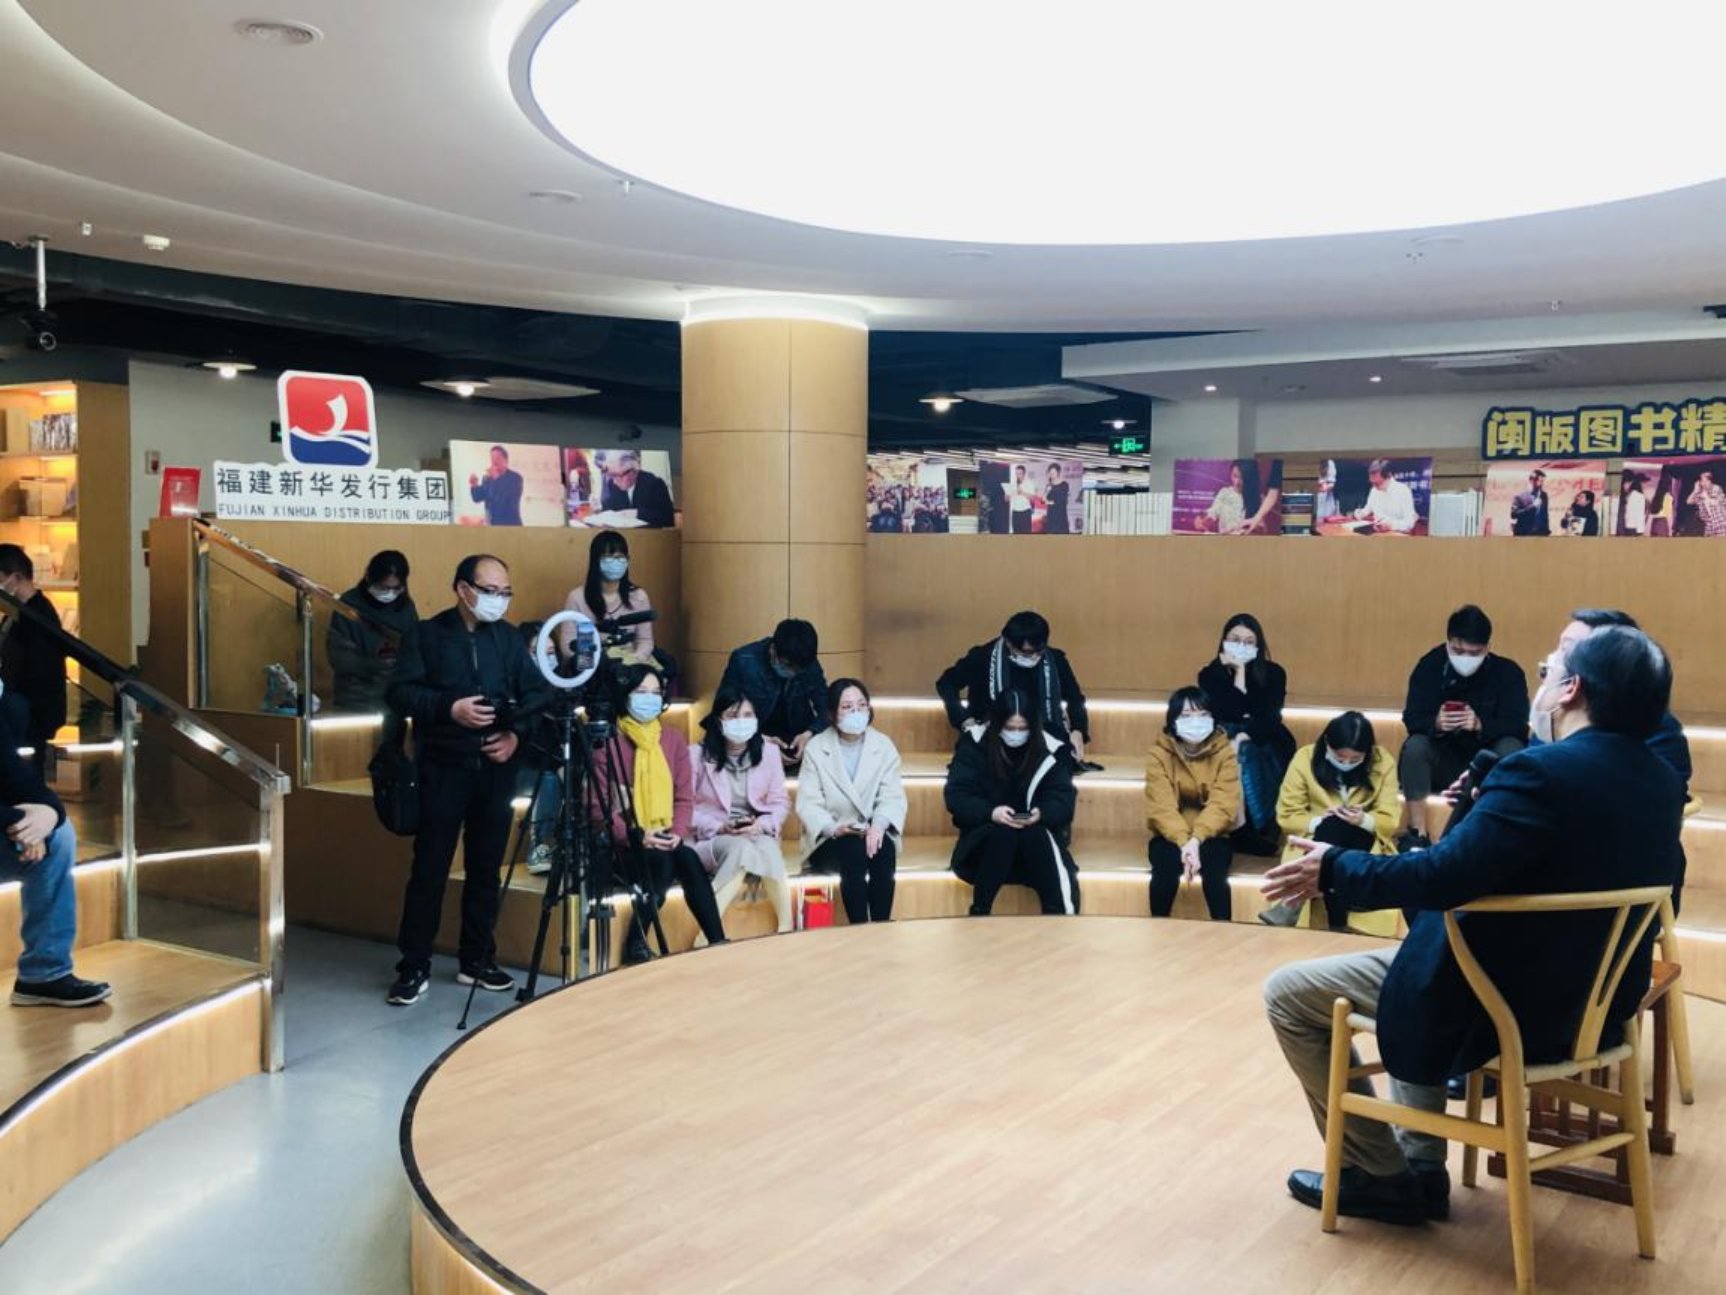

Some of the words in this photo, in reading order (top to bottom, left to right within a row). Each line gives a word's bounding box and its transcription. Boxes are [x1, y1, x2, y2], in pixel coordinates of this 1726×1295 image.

[1486, 402, 1726, 458] 闽版图书精
[217, 468, 446, 501] 福建新华发行集团
[218, 504, 265, 516] FUJIAN
[273, 505, 318, 517] XINHUA
[324, 506, 410, 520] DISTRIBUTION
[416, 509, 453, 522] GROUP
